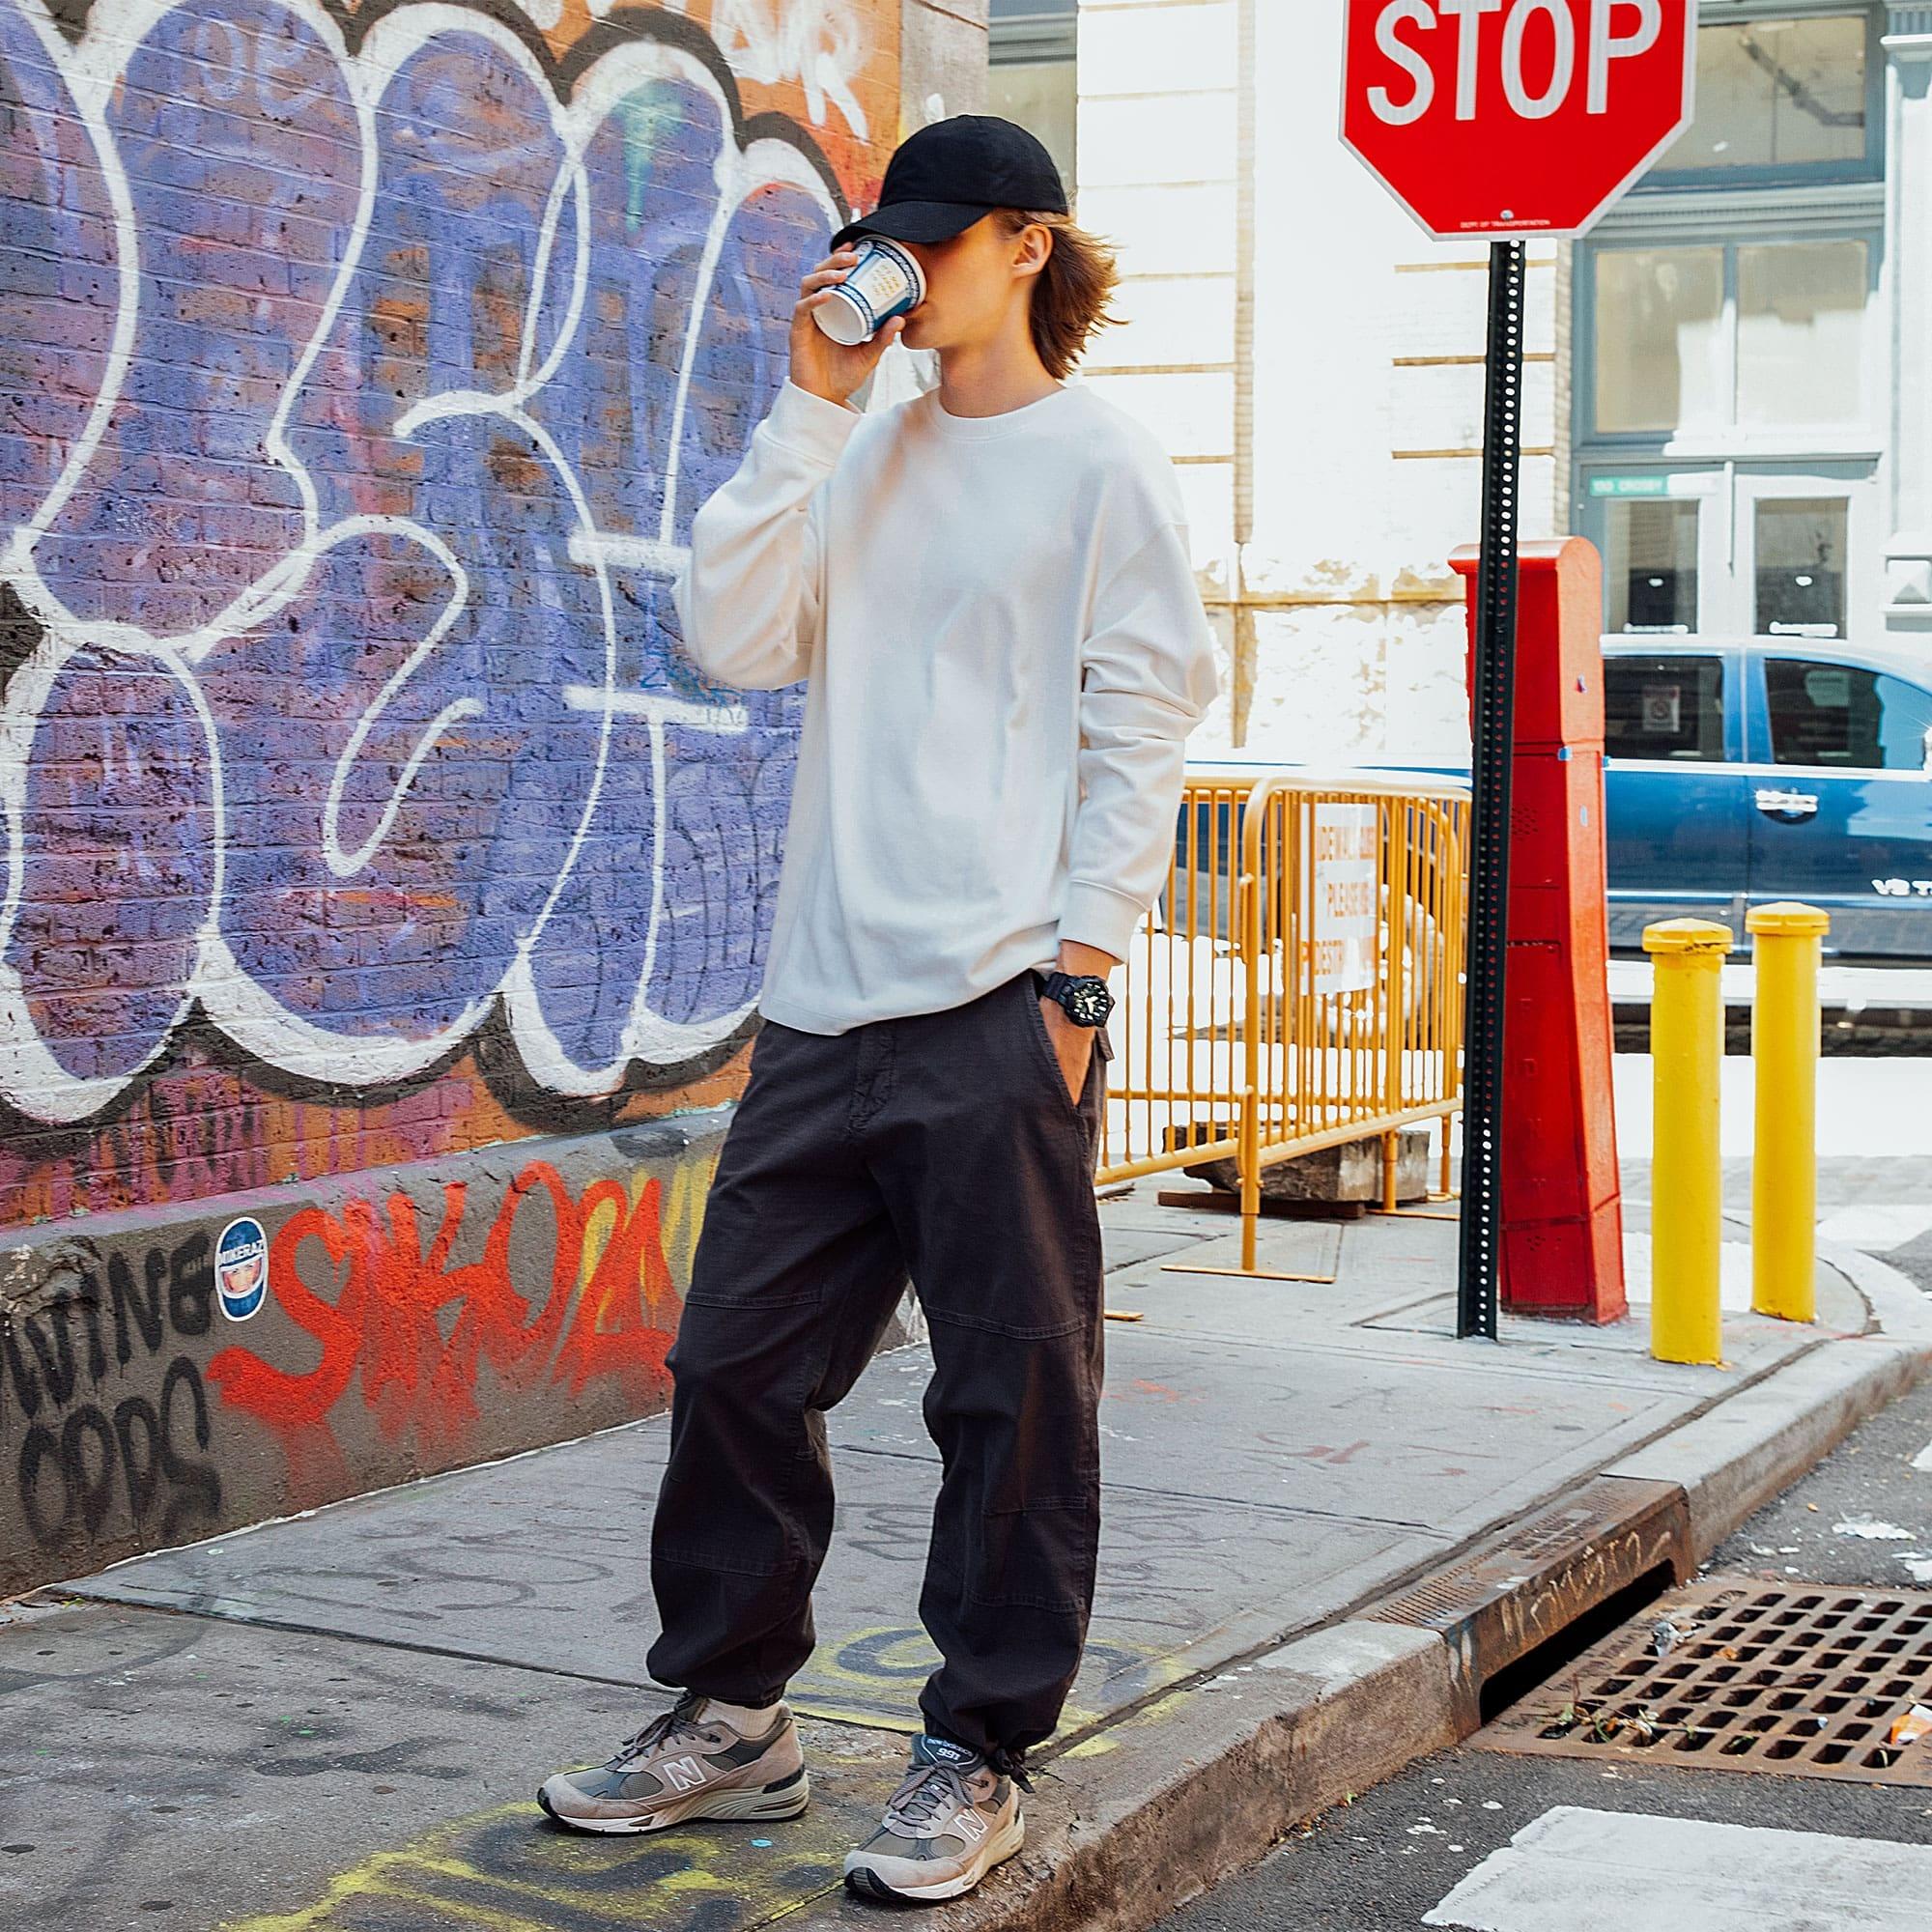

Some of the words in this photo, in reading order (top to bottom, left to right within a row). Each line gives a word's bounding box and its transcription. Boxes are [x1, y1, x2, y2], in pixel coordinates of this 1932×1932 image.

[1367, 0, 1662, 126] STOP
[936, 1747, 961, 1760] 991
[663, 1755, 707, 1791] N
[953, 1807, 988, 1842] N
